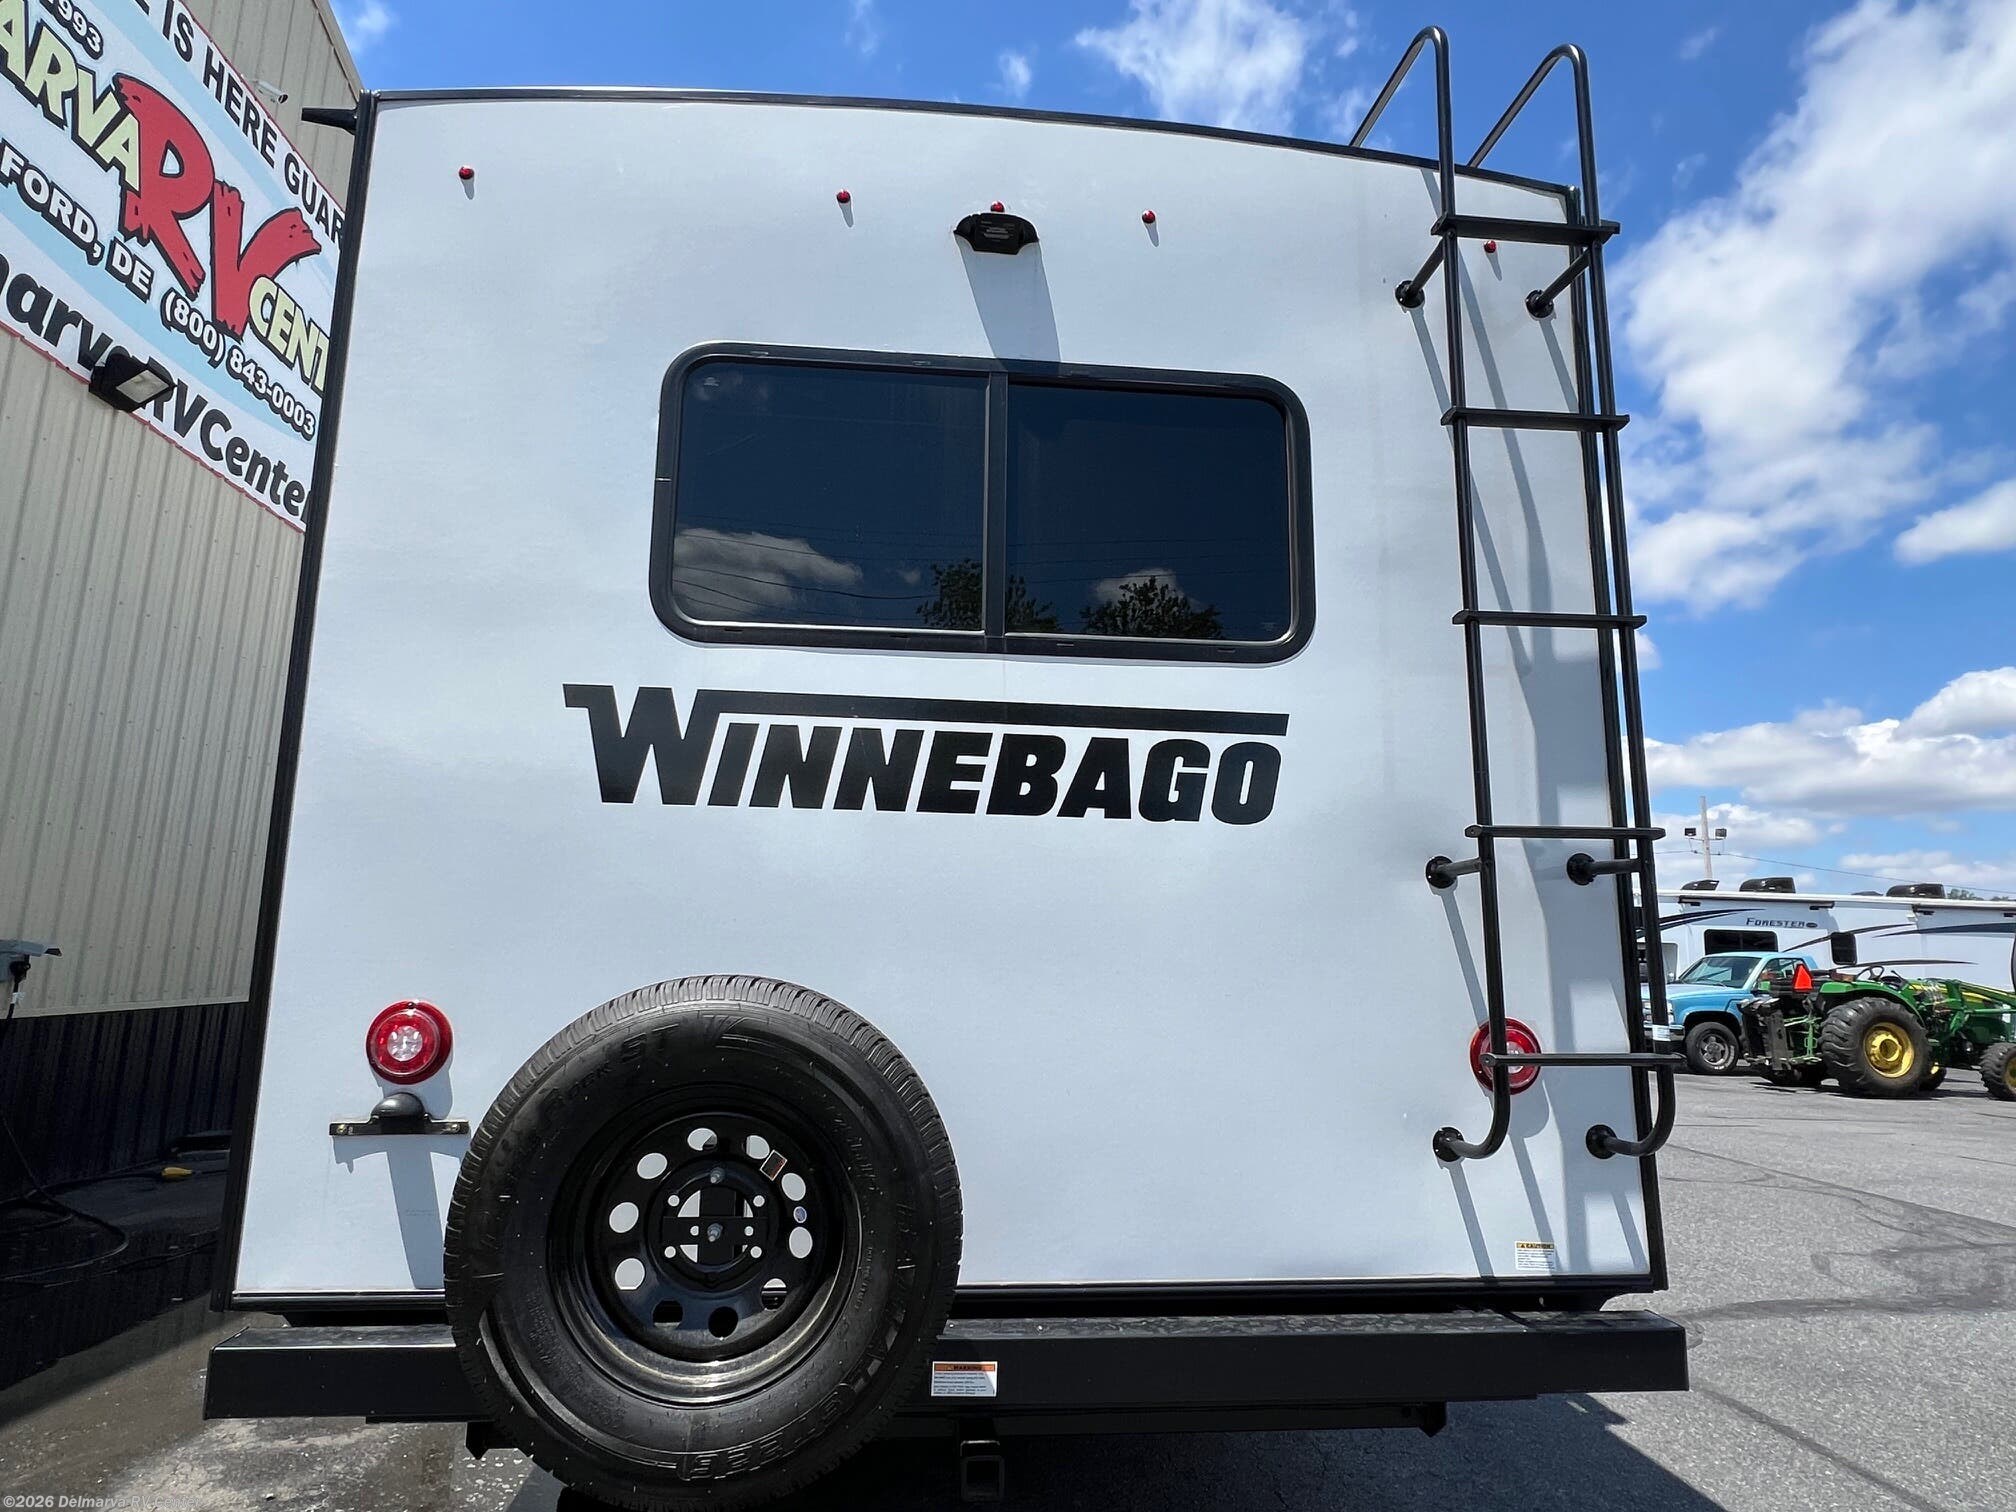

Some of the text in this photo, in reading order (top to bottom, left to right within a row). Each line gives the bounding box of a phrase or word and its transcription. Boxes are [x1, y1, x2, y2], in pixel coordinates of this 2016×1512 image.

[48, 0, 102, 54] 993
[163, 0, 194, 62] IS
[203, 45, 277, 168] HERE
[113, 73, 321, 344] RV
[111, 242, 152, 295] DE
[164, 298, 226, 362] (800)
[229, 349, 316, 436] 843-0003
[562, 684, 1289, 825] WINNEBAGO
[1746, 917, 1805, 929] FORESTER
